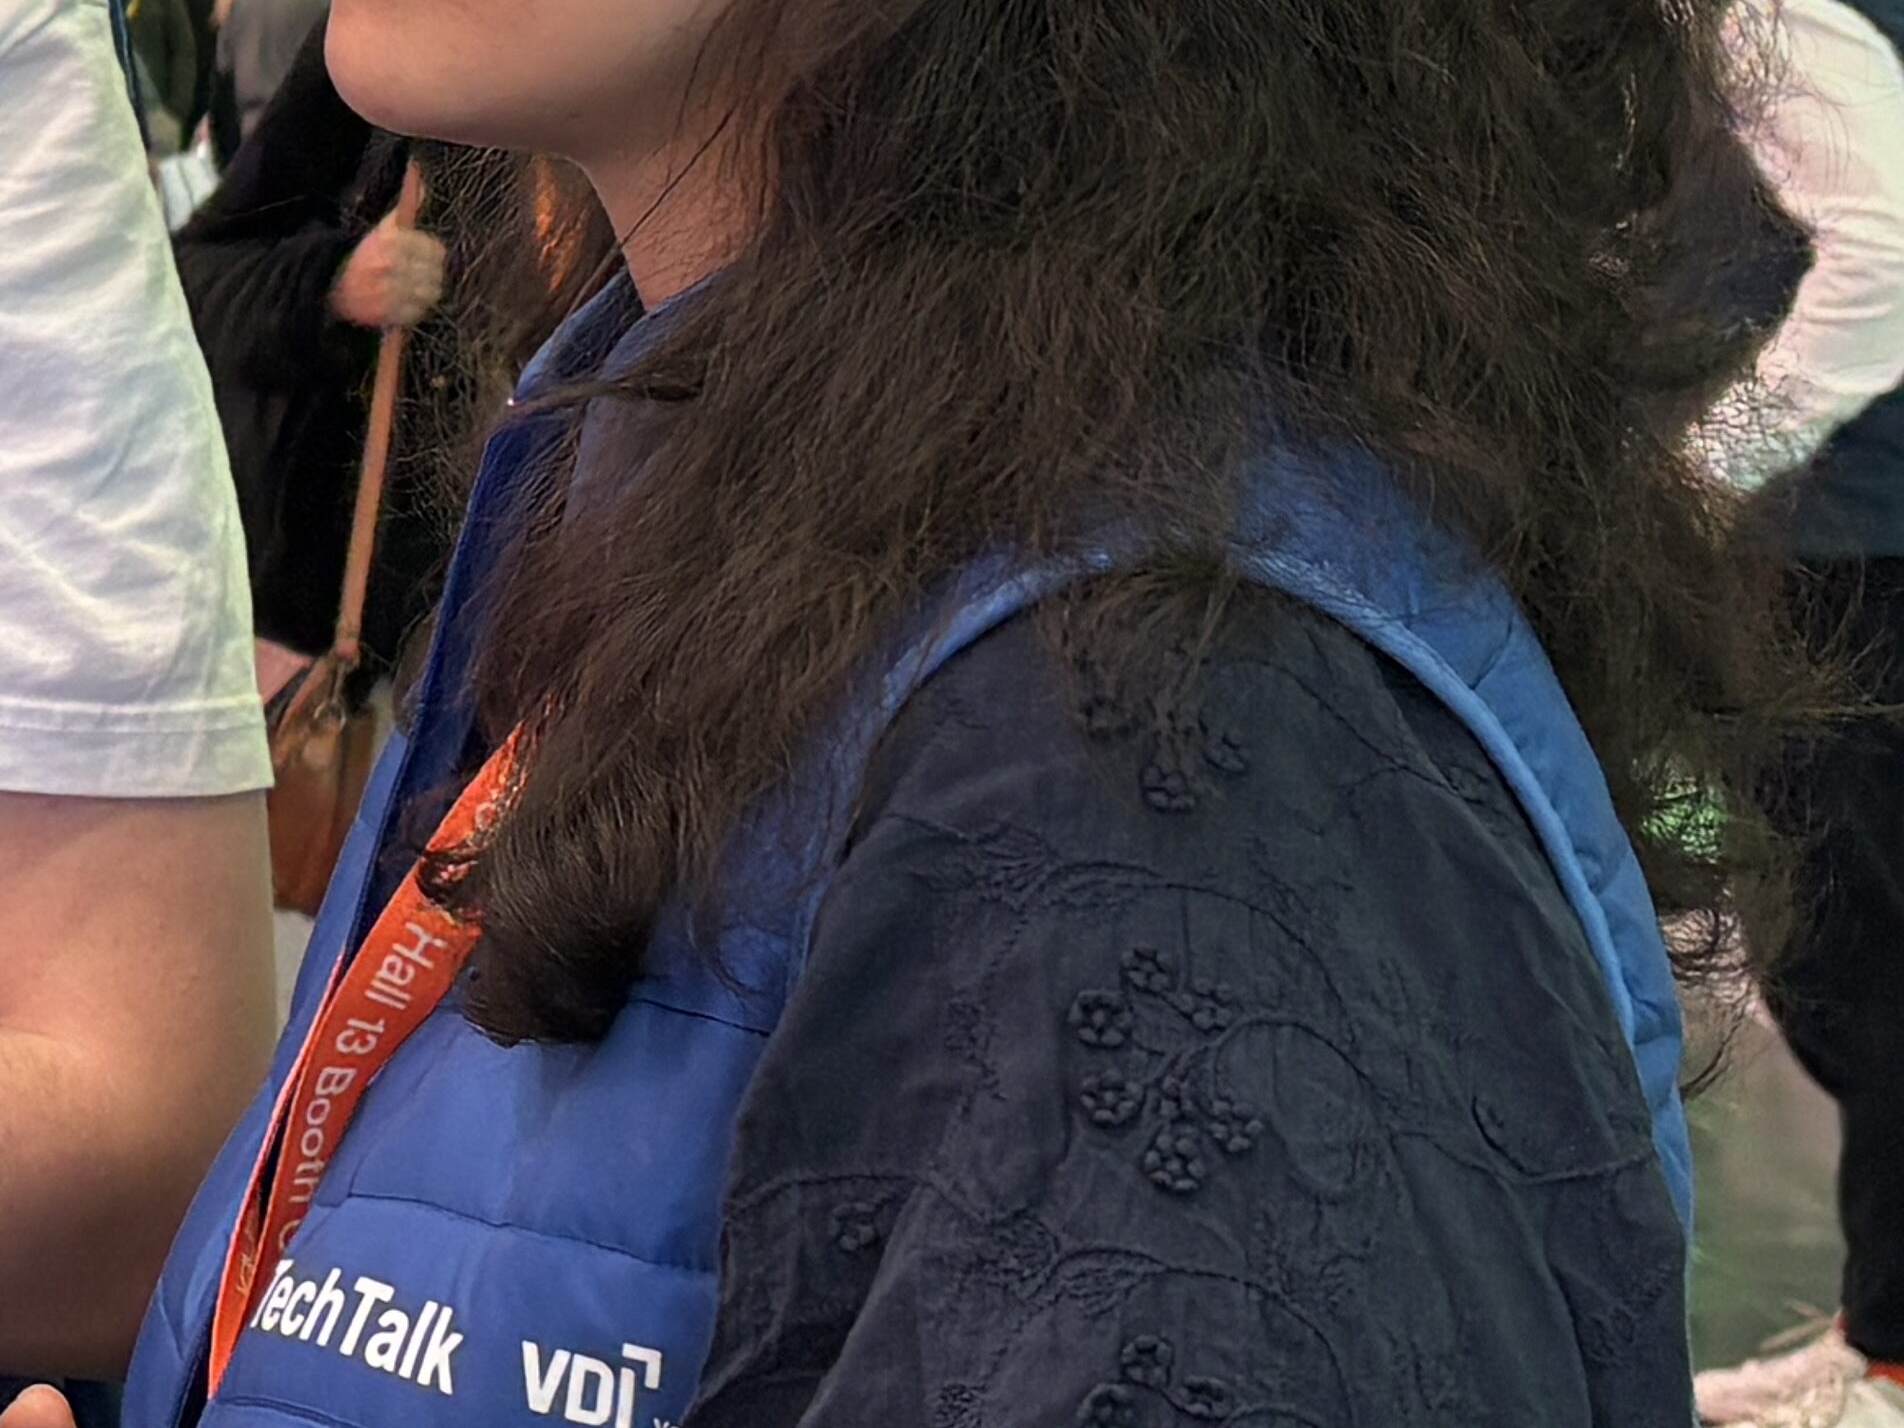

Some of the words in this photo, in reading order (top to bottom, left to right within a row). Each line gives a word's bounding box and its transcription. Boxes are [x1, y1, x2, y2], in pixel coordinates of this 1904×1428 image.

[364, 922, 449, 1011] Hall
[335, 1018, 386, 1055] 13
[288, 1066, 357, 1203] Booth
[522, 1341, 647, 1428] VDI
